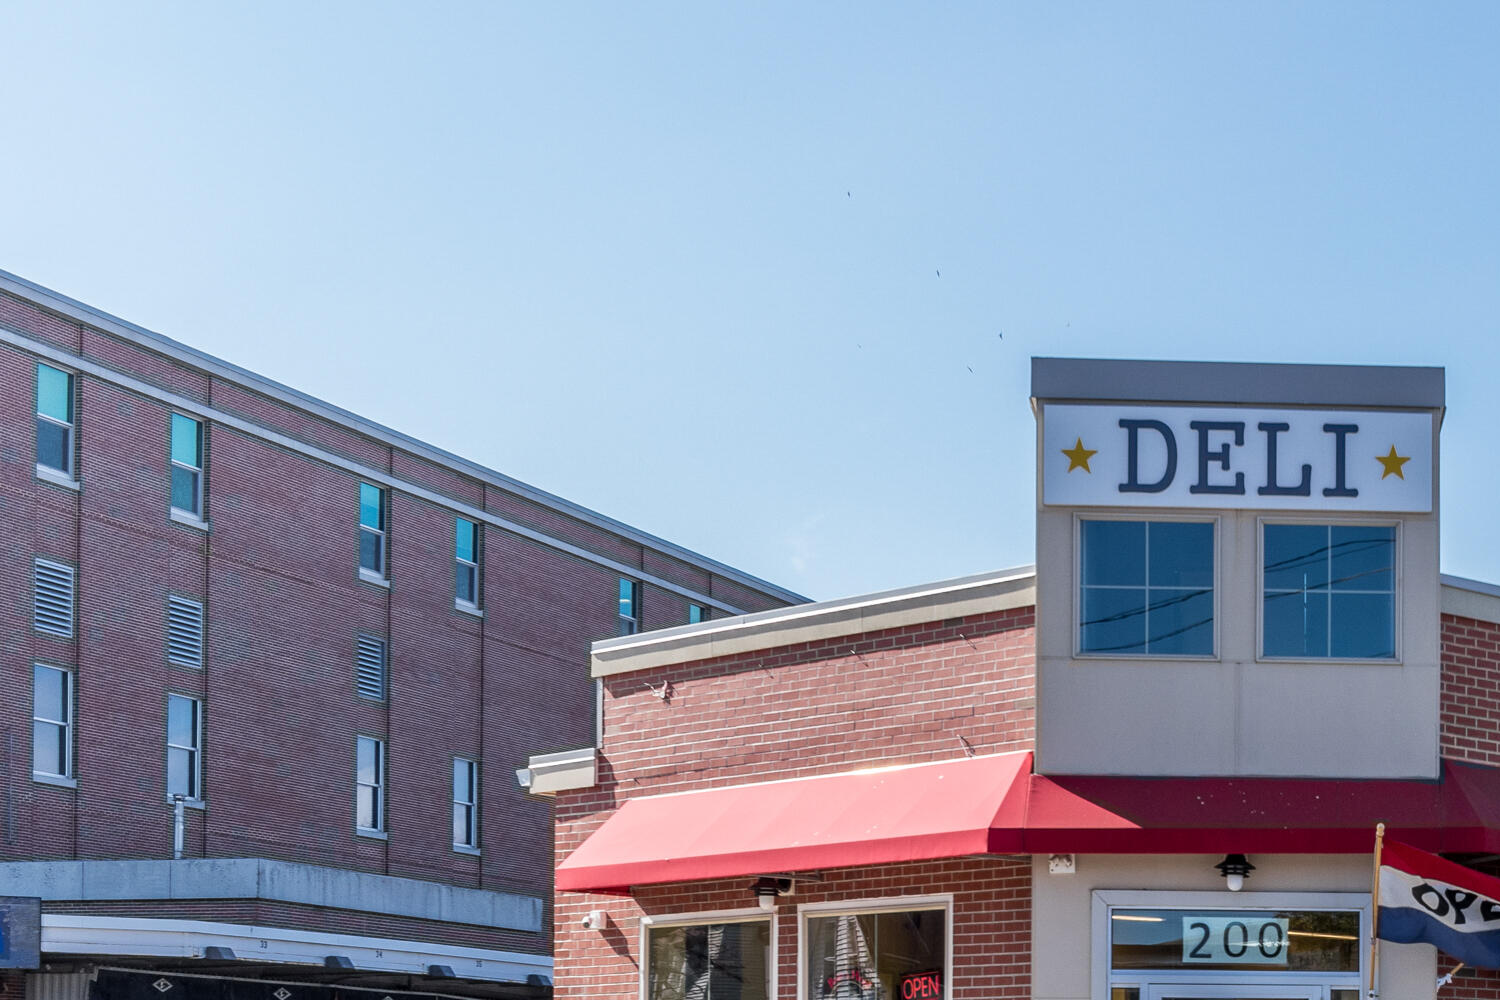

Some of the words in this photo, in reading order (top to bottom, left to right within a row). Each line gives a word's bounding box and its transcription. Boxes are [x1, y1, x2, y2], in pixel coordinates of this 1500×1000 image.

[1118, 419, 1359, 497] DELI
[1189, 921, 1284, 958] 200
[903, 975, 939, 1000] OPEN
